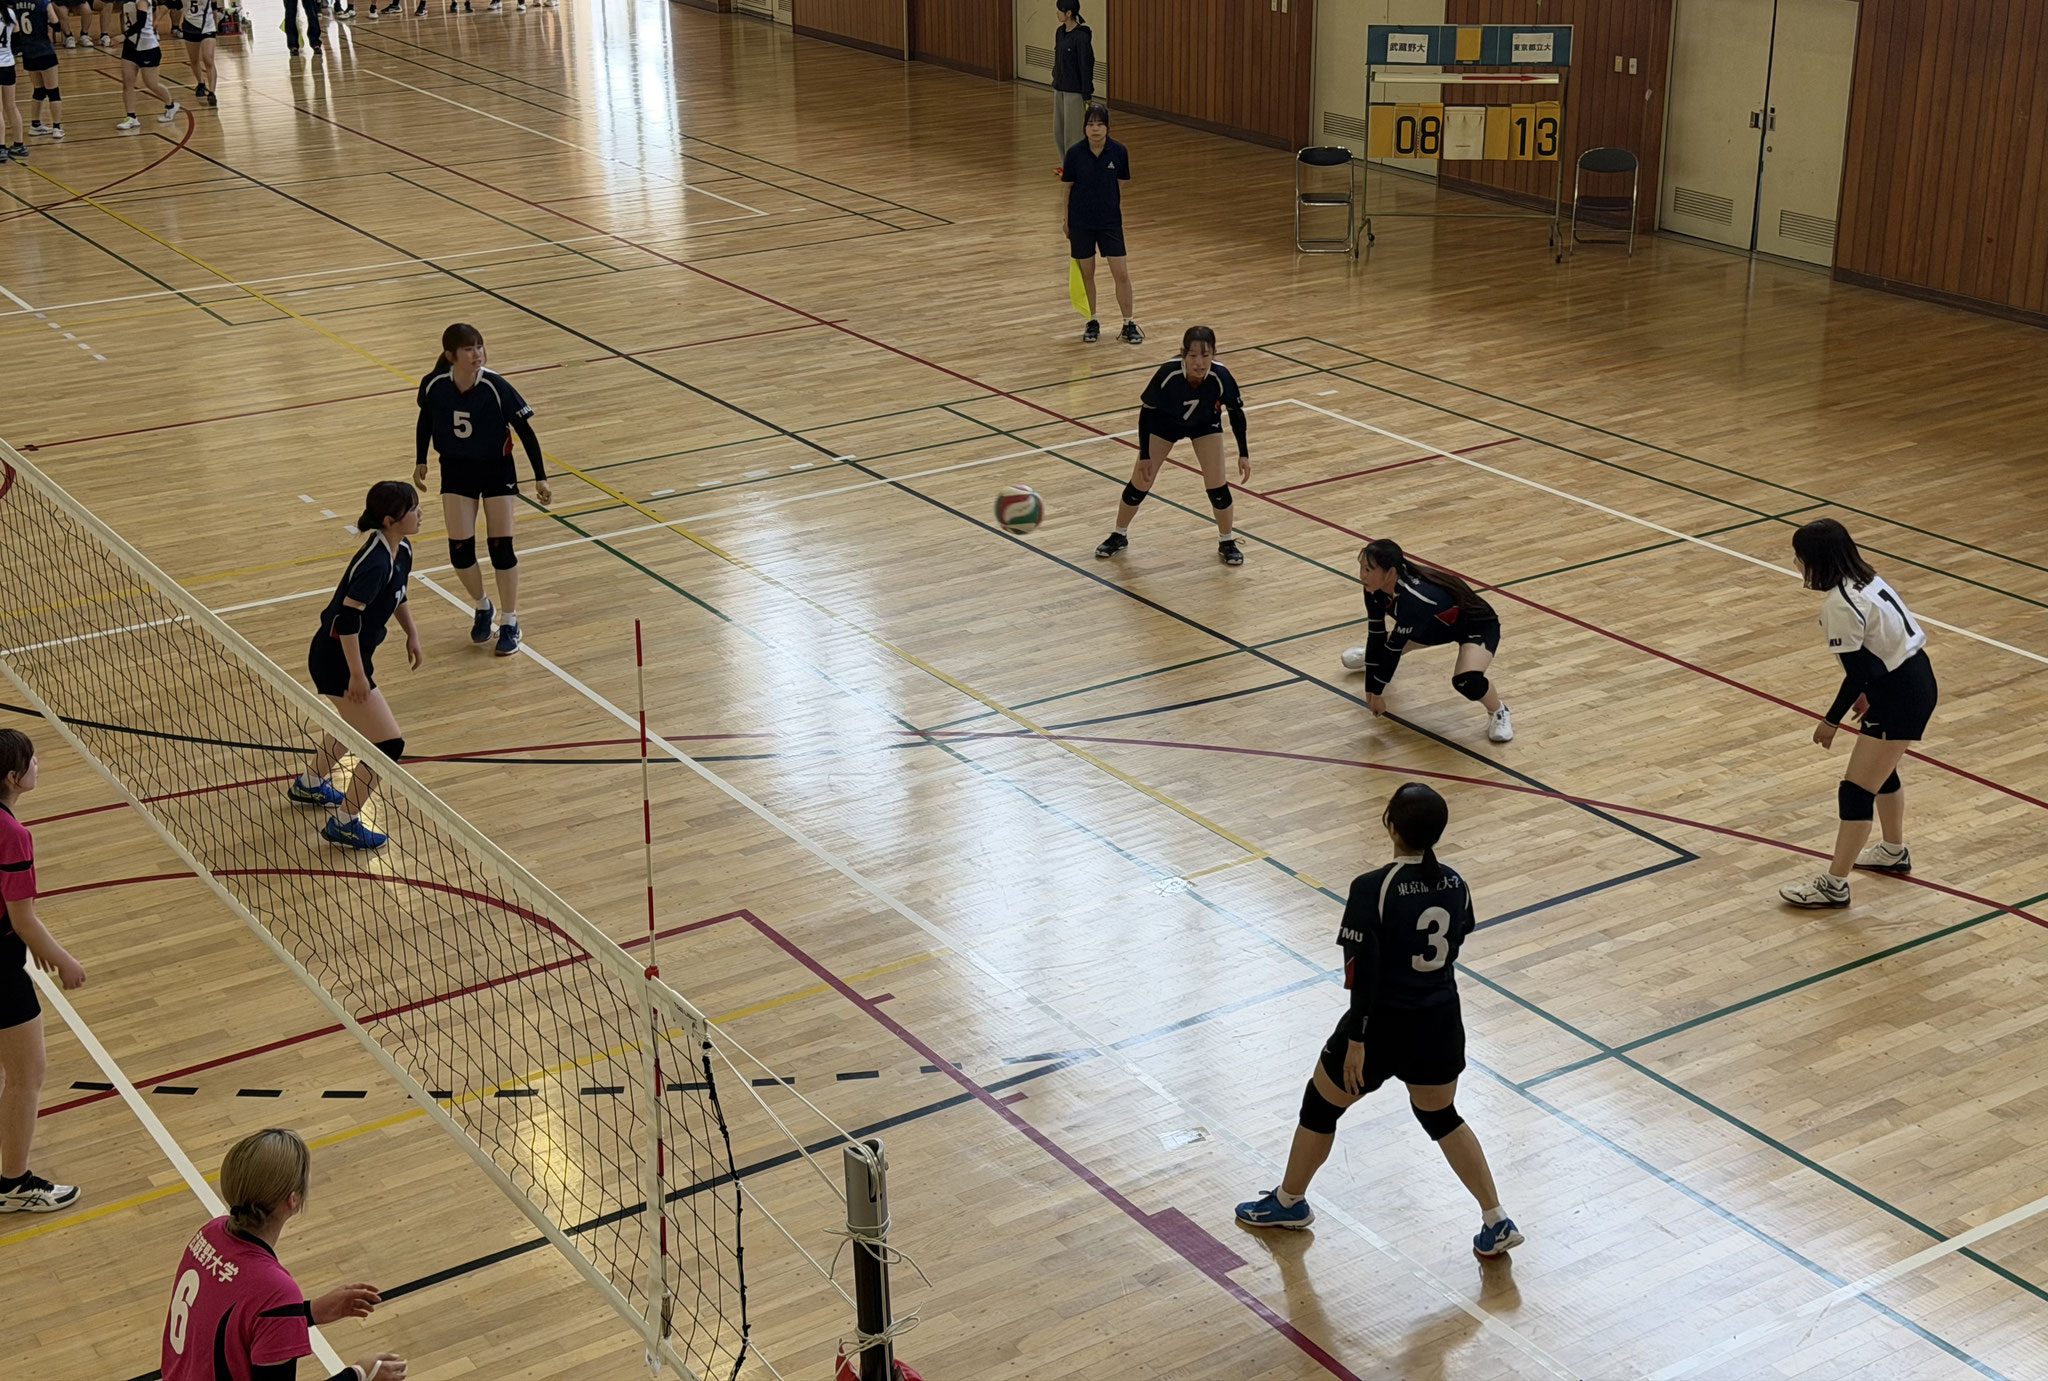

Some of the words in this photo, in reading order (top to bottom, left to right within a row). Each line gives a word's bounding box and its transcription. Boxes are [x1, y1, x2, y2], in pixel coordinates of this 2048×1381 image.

[21, 12, 33, 35] 6
[1389, 42, 1426, 53] 武蔵野大
[1513, 42, 1552, 52] 東京都立大
[1396, 115, 1441, 155] 08
[1515, 117, 1558, 156] 13
[453, 410, 473, 439] 5
[1183, 399, 1200, 421] 7
[1877, 588, 1916, 637] 1
[1395, 625, 1413, 635] MU
[1411, 906, 1451, 973] 3
[169, 1268, 200, 1356] 6
